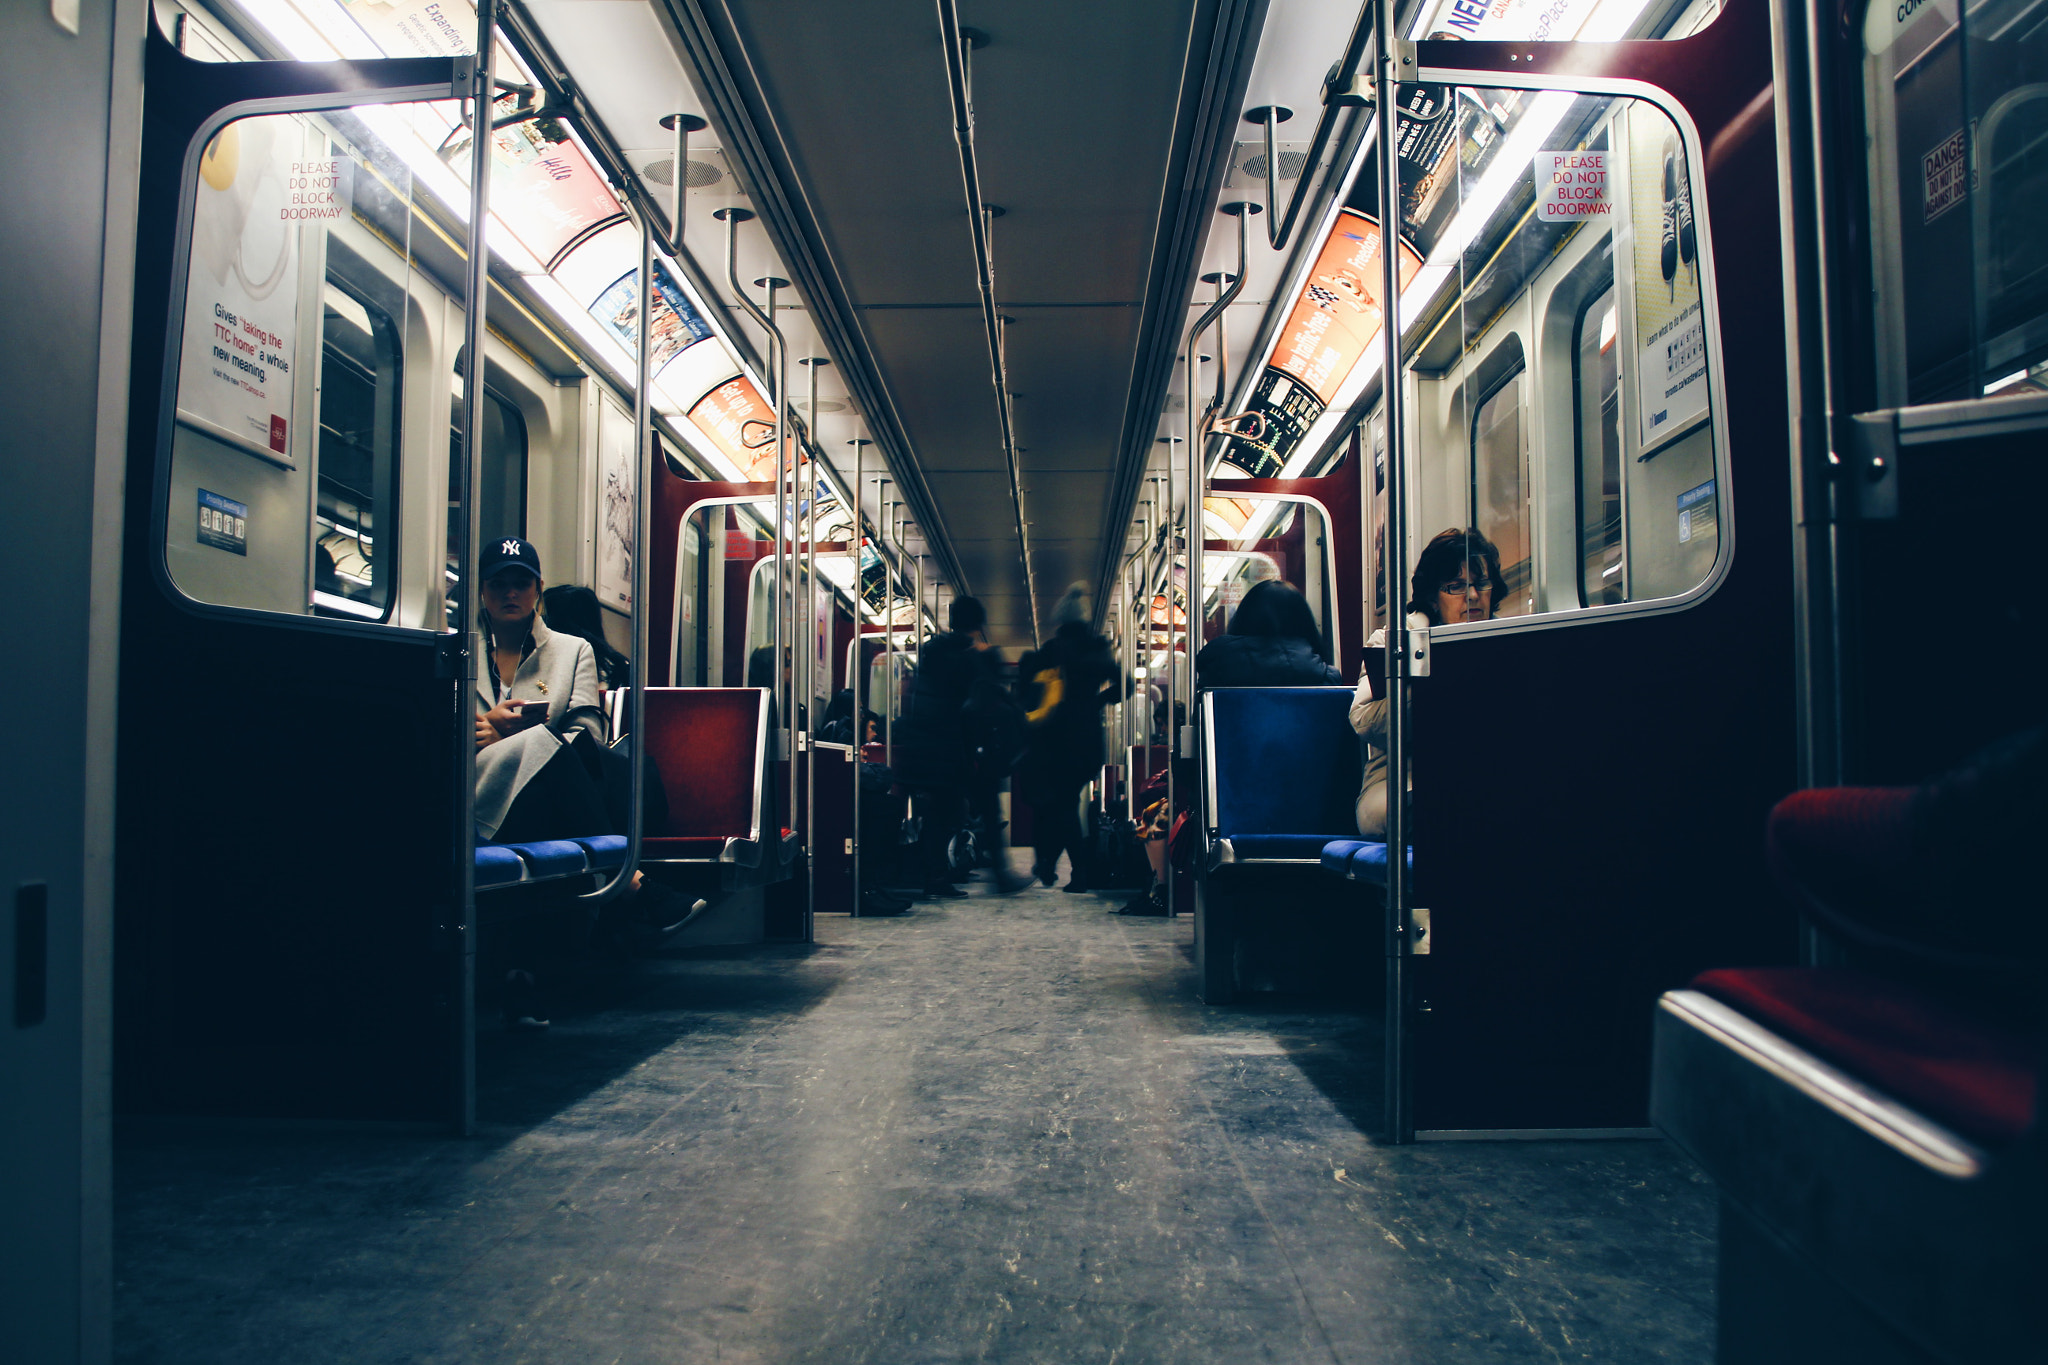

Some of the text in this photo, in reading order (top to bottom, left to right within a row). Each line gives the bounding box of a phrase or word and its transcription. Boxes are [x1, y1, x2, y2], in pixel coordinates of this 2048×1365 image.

[424, 2, 465, 48] Expanding
[1529, 0, 1569, 41] isaPlace
[292, 161, 339, 174] PLEASE
[534, 156, 573, 181] Hello
[1554, 156, 1604, 168] PLEASE
[1925, 135, 1965, 178] DANGE
[289, 176, 340, 190] DO NOT
[1553, 171, 1606, 184] DO NOT
[292, 191, 335, 205] BLOCK
[1558, 187, 1603, 200] BLOCK
[280, 206, 343, 221] DOORWAY
[1547, 203, 1613, 215] DOORWAY
[1346, 230, 1381, 271] Freedom
[214, 302, 237, 327] Gives
[268, 332, 283, 349] the
[214, 322, 231, 343] TTC
[259, 350, 265, 361] a
[266, 353, 289, 373] whole
[213, 345, 267, 383] new meaning.
[1280, 354, 1307, 378] New
[718, 381, 755, 417] Get up to
[502, 539, 520, 556] NY
